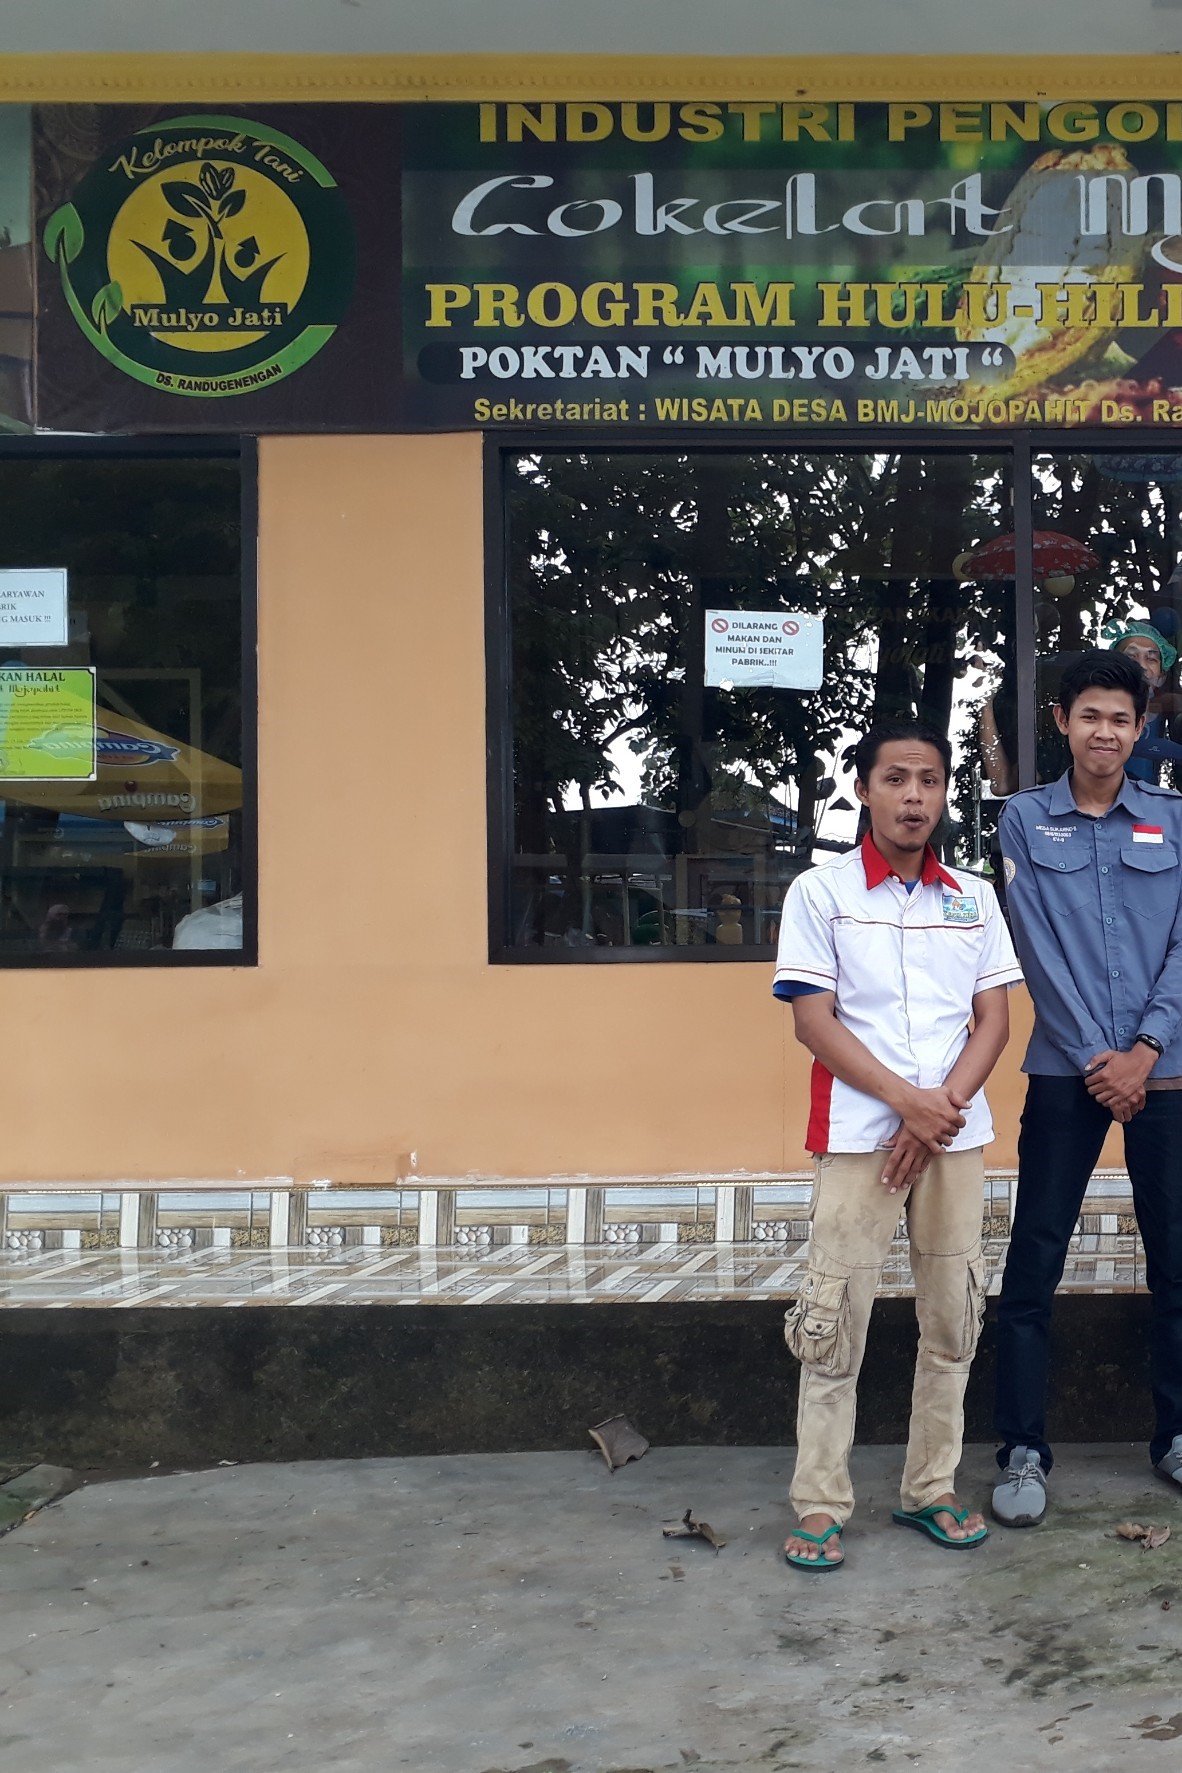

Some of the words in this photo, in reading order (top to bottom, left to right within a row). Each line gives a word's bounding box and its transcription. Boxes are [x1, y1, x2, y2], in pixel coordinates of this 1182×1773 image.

[479, 102, 855, 143] INDUSTRI
[108, 132, 248, 180] Kelompok
[252, 140, 304, 183] Tani
[451, 171, 1014, 240] Cokelat
[425, 281, 796, 328] PROGRAM
[133, 306, 219, 331] Mulyo
[228, 306, 284, 327] Jati
[459, 345, 650, 379] POKTAN
[696, 344, 855, 380] MULYO
[866, 344, 971, 380] JATI
[155, 370, 175, 388] DS.
[177, 363, 284, 393] RANDUGENENGAN
[473, 398, 629, 423] Sekretariat
[655, 399, 762, 422] WISATA
[771, 399, 848, 423] DESA
[857, 399, 1091, 424] BMJ-MOJOPAHIT
[1101, 399, 1143, 424] Ds.
[0, 590, 45, 598] ARYAWAN
[10, 615, 42, 623] MASUK
[731, 622, 778, 631] DILARANG
[715, 646, 746, 654] MINUM
[748, 646, 757, 654] DI
[759, 647, 794, 655] SEKITAR
[727, 634, 760, 643] MAKAN
[762, 635, 782, 643] DAN
[26, 672, 65, 682] HALAL
